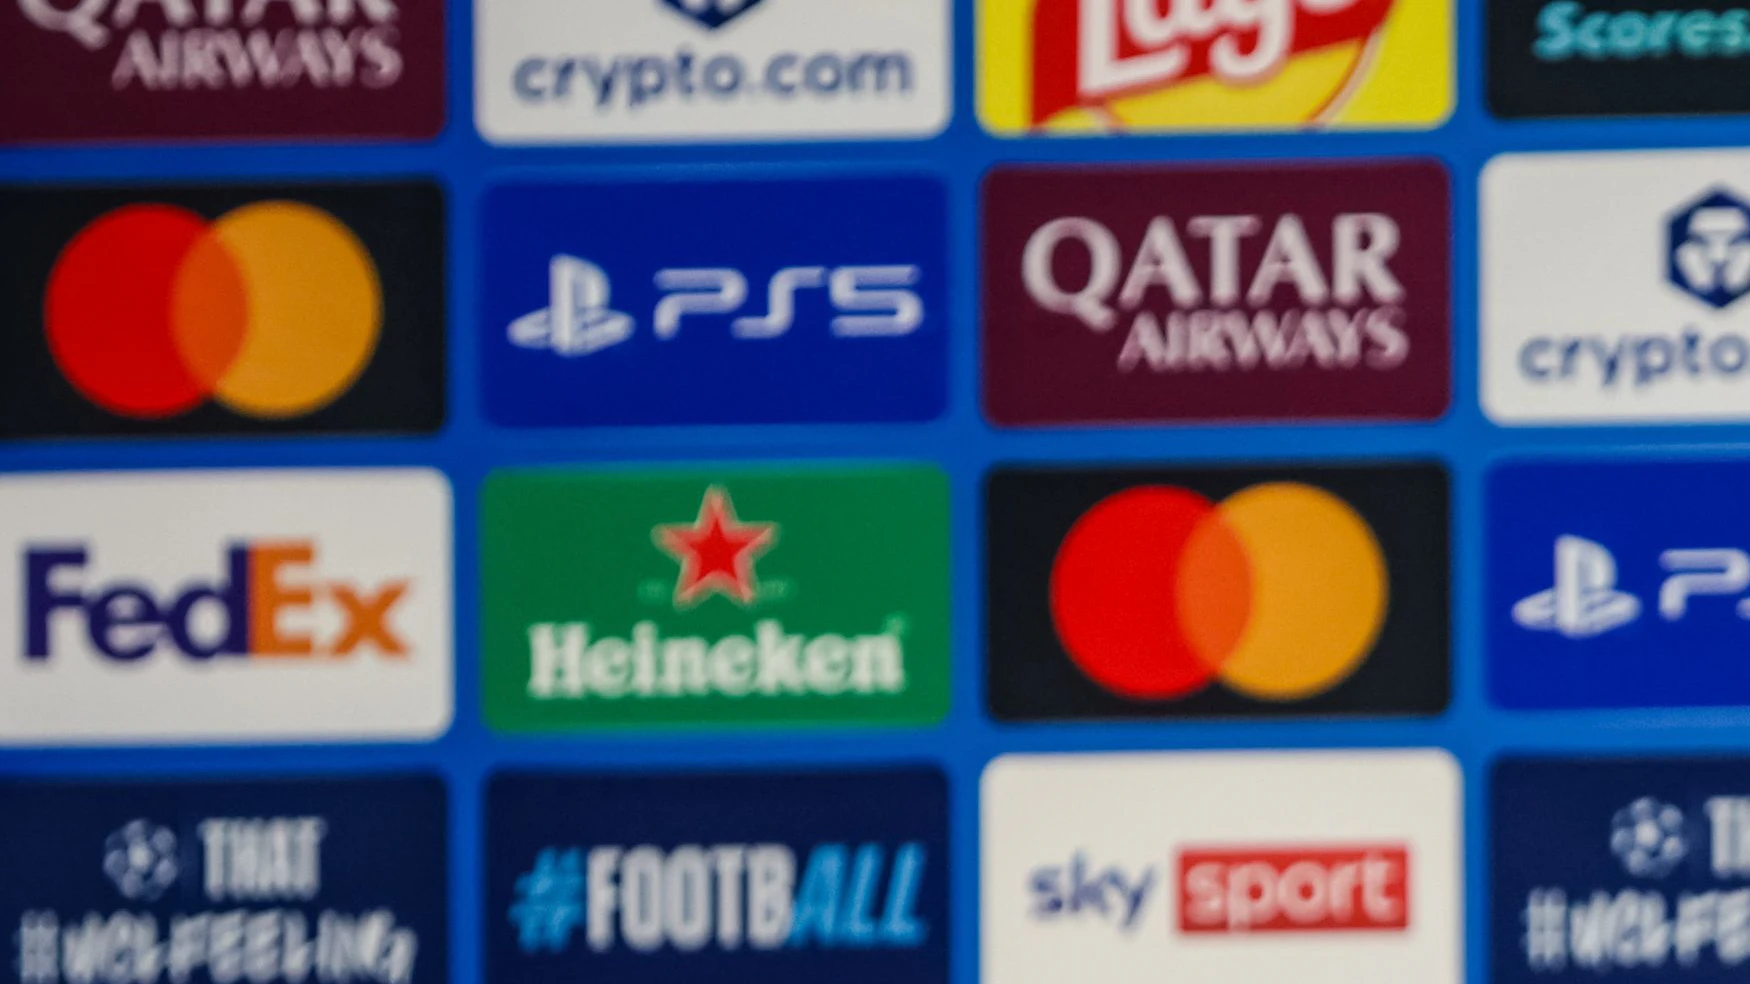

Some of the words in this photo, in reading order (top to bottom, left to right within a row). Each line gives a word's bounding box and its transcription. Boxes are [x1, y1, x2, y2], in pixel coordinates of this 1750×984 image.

[112, 27, 403, 90] AIRWAYS
[512, 46, 912, 108] crypto.com
[652, 265, 924, 338] PS5
[1021, 213, 1405, 330] QATAR
[1117, 307, 1409, 372] AIRWAYS
[20, 540, 413, 664] FedEx
[526, 619, 906, 699] Heineken
[198, 816, 327, 900] THAT
[510, 843, 925, 950] #FOOTBALL
[1027, 850, 1155, 936] sky
[1183, 852, 1403, 930] sport
